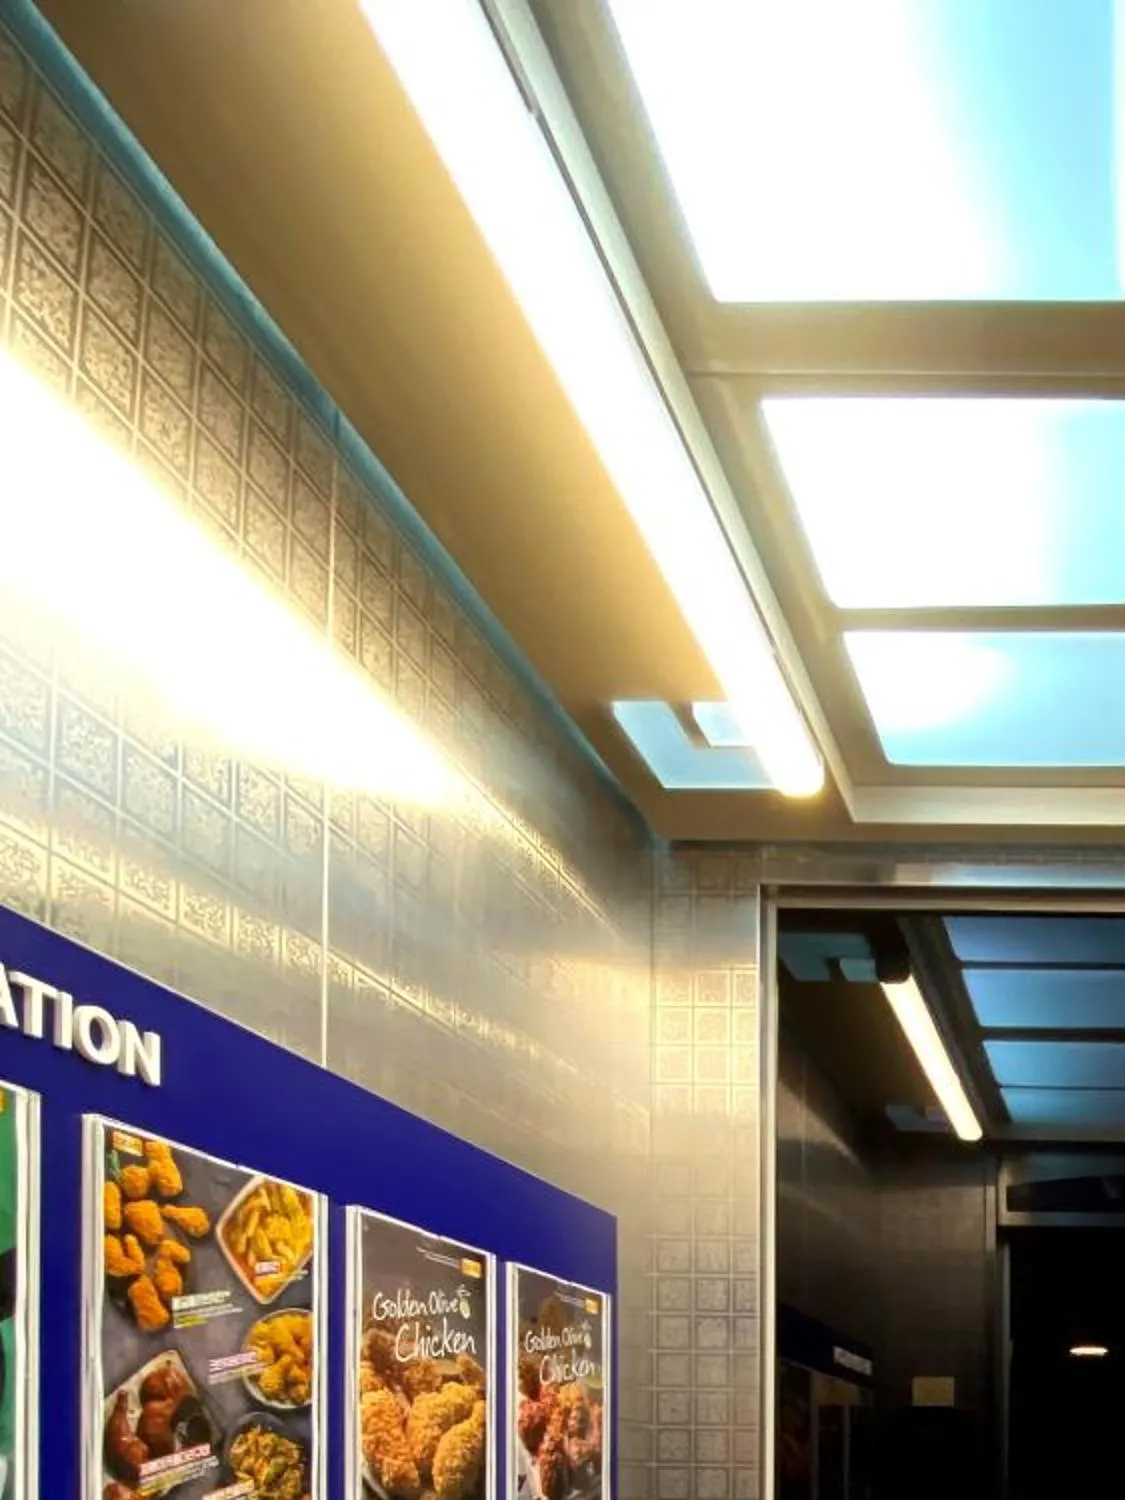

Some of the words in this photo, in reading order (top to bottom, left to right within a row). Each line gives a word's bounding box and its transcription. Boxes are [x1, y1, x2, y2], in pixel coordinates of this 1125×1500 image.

[372, 1287, 428, 1320] Golden
[429, 1289, 459, 1314] Olive
[395, 1316, 477, 1362] Chicken
[524, 1325, 562, 1353] Golden
[539, 1348, 595, 1385] Chicken
